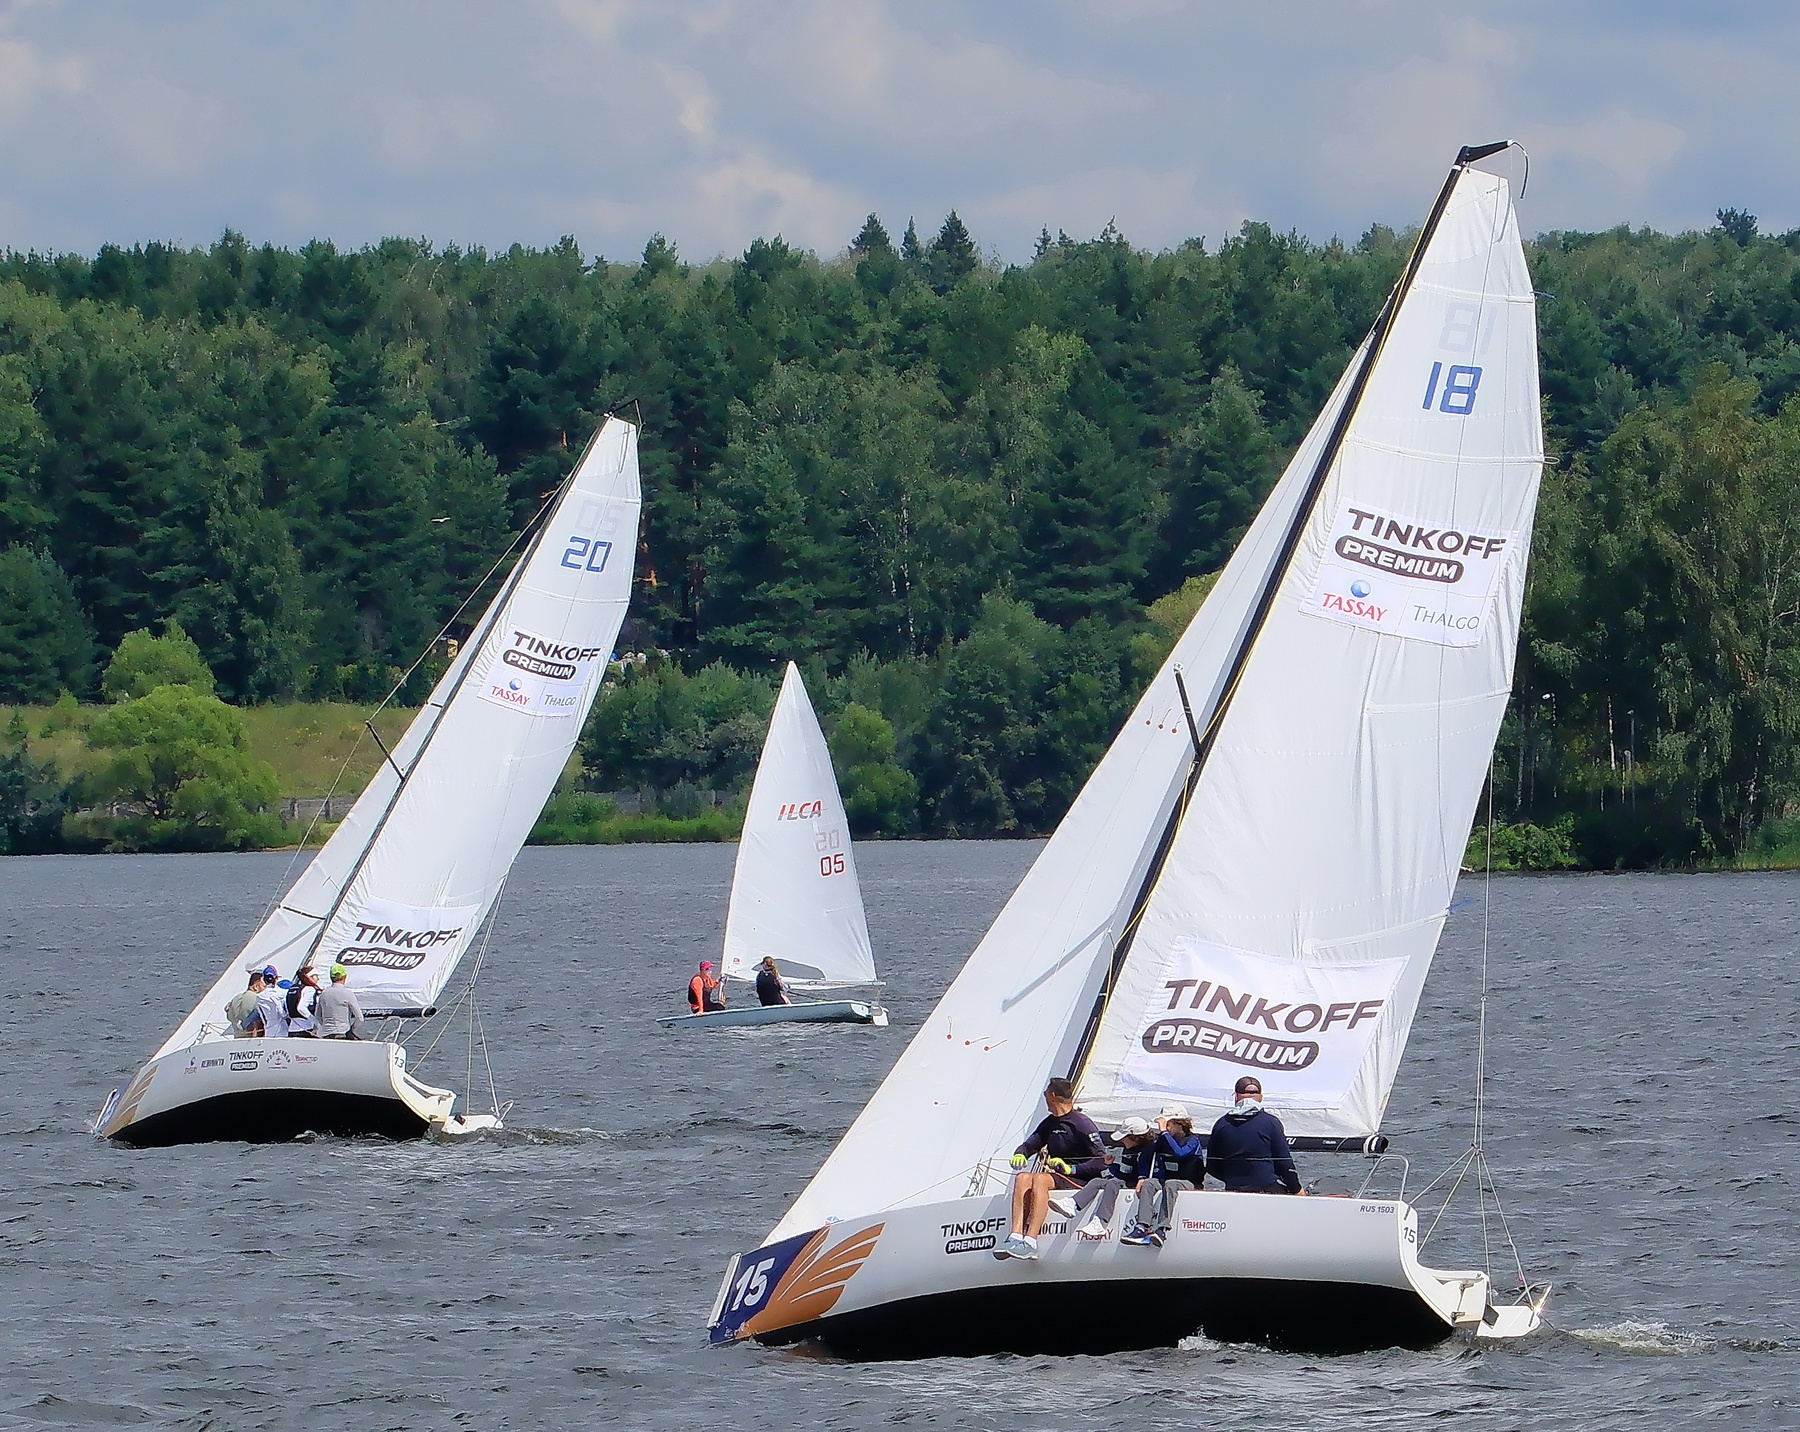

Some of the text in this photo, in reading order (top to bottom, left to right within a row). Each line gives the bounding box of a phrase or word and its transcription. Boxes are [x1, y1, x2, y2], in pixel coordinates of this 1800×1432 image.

[1422, 361, 1483, 415] 18
[1348, 508, 1506, 560] TINKOFF
[561, 536, 612, 572] 20
[1342, 540, 1459, 579] PREMIUM
[1322, 593, 1387, 621] TASSAY
[1413, 605, 1480, 630] THALGO
[514, 630, 600, 662] TINKOFF
[507, 652, 574, 678] PREMIUM
[491, 685, 530, 706] TASSAY
[777, 800, 822, 821] ILCA
[820, 853, 844, 876] 05
[355, 922, 462, 948] TINKOFF
[341, 949, 422, 967] PREMIUM
[1164, 979, 1384, 1033] TINKOFF
[229, 1050, 264, 1060] TINKOFF
[1151, 1024, 1310, 1065] PREMIUM
[941, 1218, 1006, 1237] TINKOFF
[1403, 1227, 1416, 1243] 15
[948, 1237, 994, 1251] PREMIUM
[731, 1257, 775, 1311] 15
